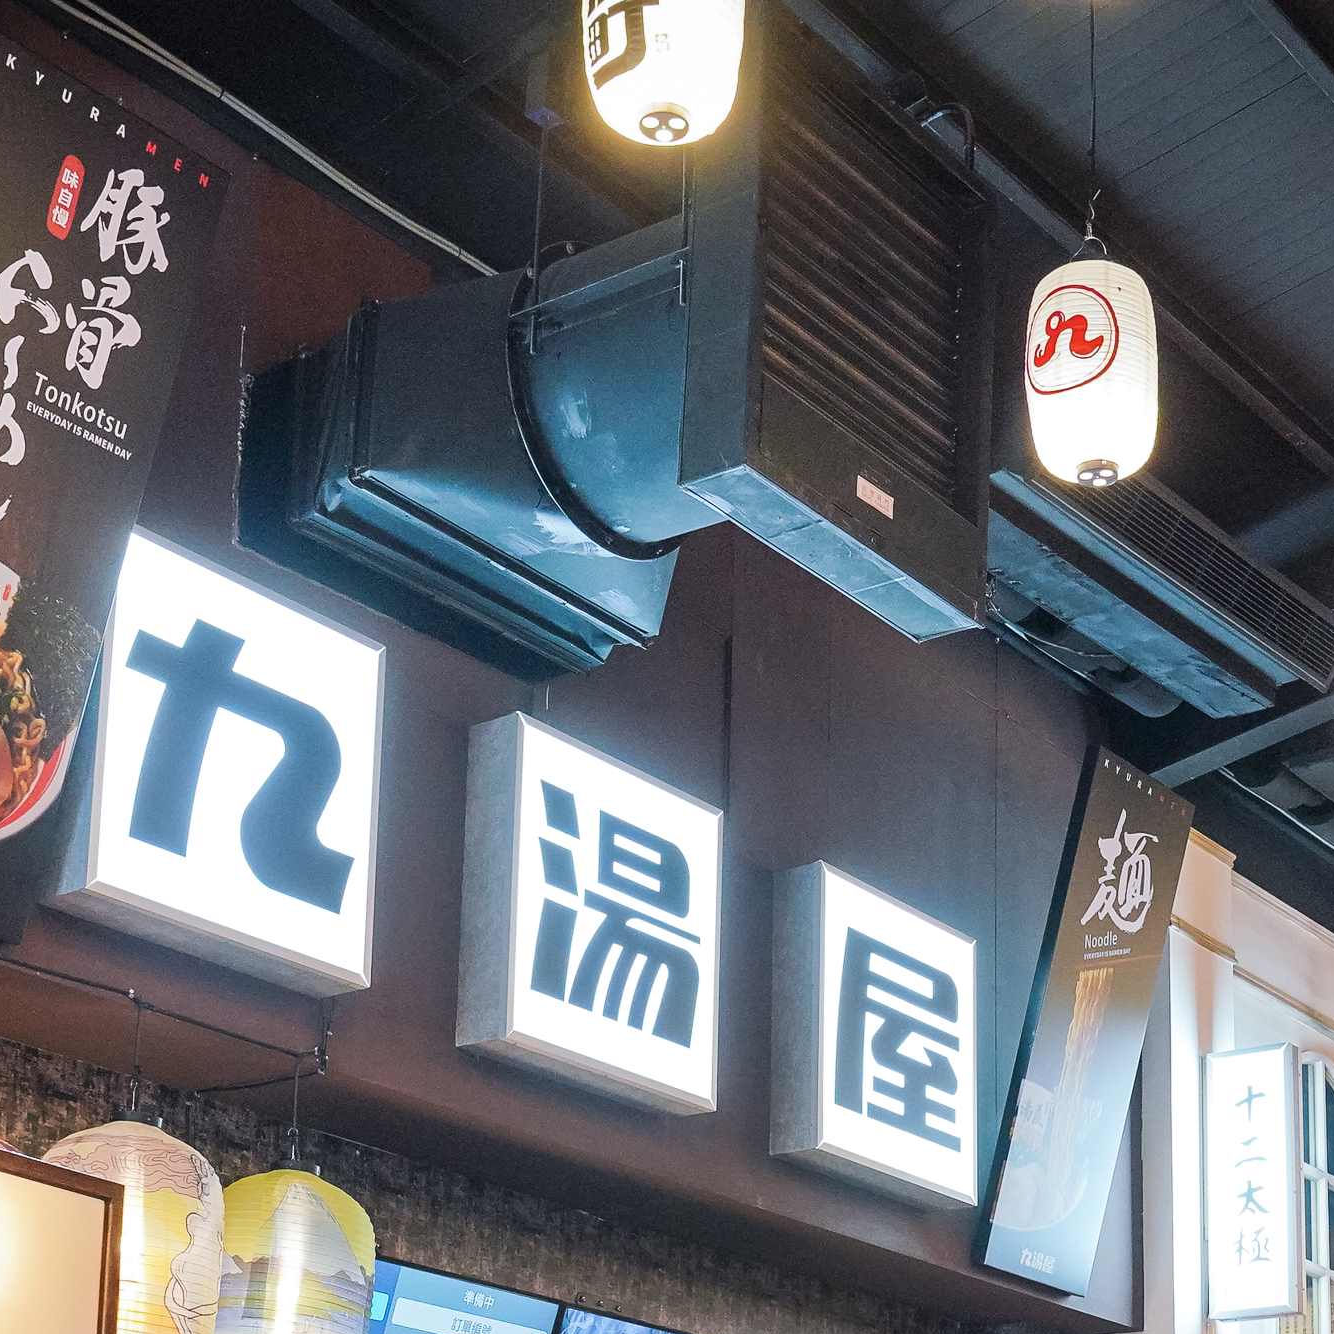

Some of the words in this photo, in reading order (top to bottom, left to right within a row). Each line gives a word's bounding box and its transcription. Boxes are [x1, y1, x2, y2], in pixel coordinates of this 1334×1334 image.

[5, 53, 211, 188] KYURAMEN
[51, 167, 80, 229] 味自慢
[26, 401, 73, 434] EVERYDAY
[82, 425, 115, 453] RAMEN
[113, 442, 133, 461] DAY
[33, 371, 128, 440] Tonkotsu
[1084, 934, 1118, 949] Noodle
[1234, 1085, 1272, 1265] 十二太極
[463, 1290, 495, 1309] 準備中
